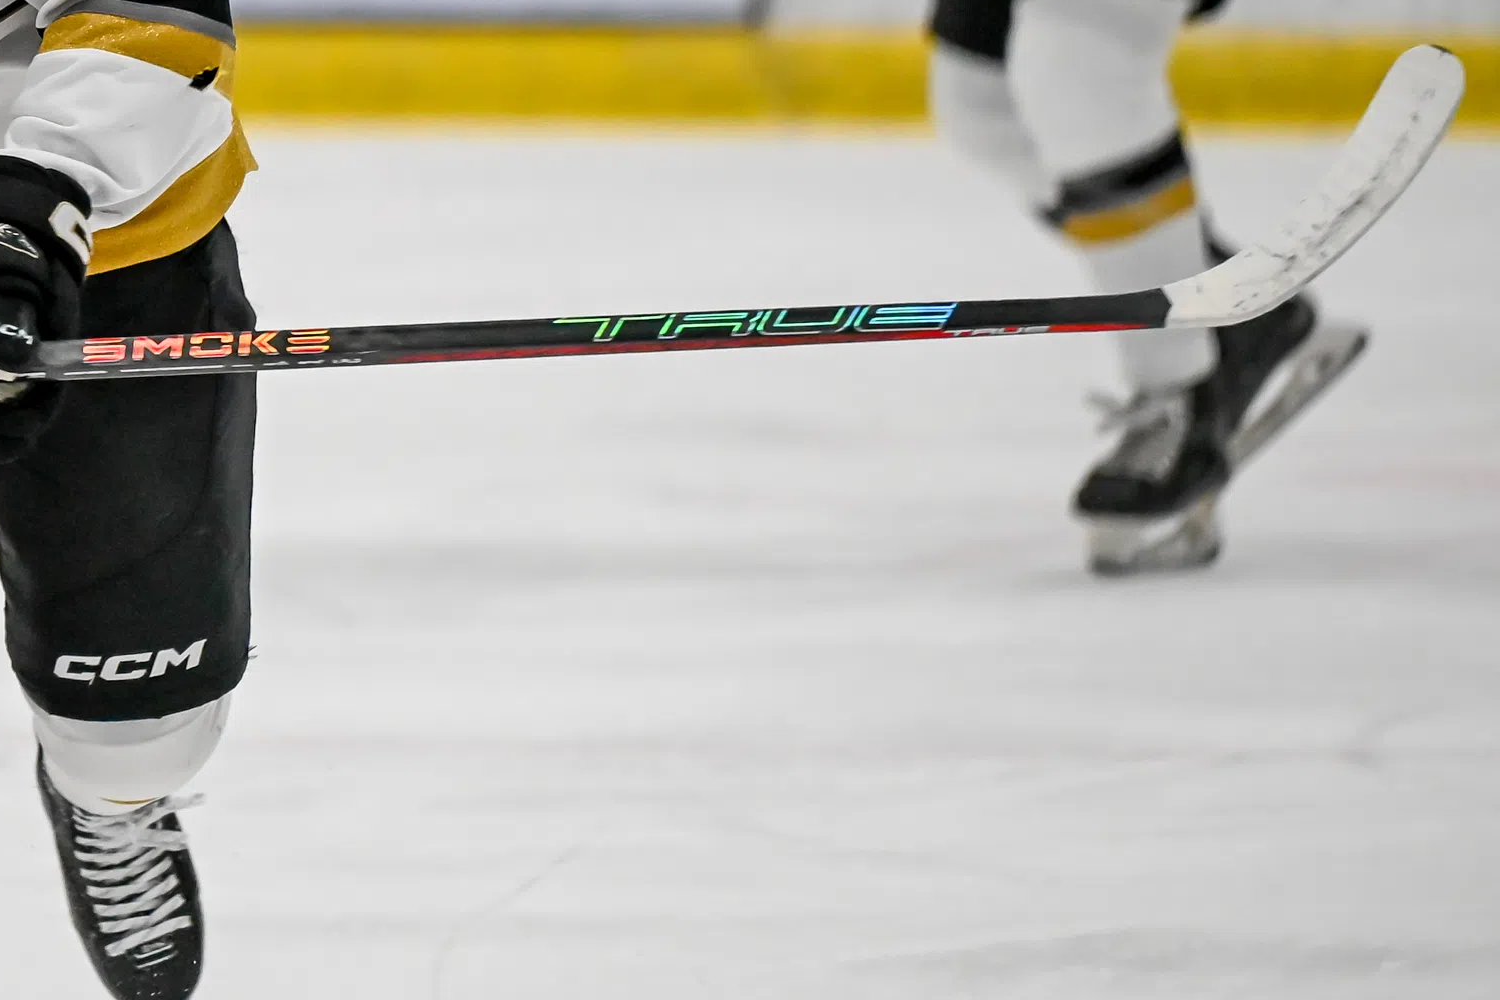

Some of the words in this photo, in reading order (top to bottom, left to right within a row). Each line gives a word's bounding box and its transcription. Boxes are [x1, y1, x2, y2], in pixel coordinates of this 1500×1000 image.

[552, 302, 959, 343] TRUE
[82, 327, 331, 364] SMOKE
[53, 638, 208, 685] CCM
